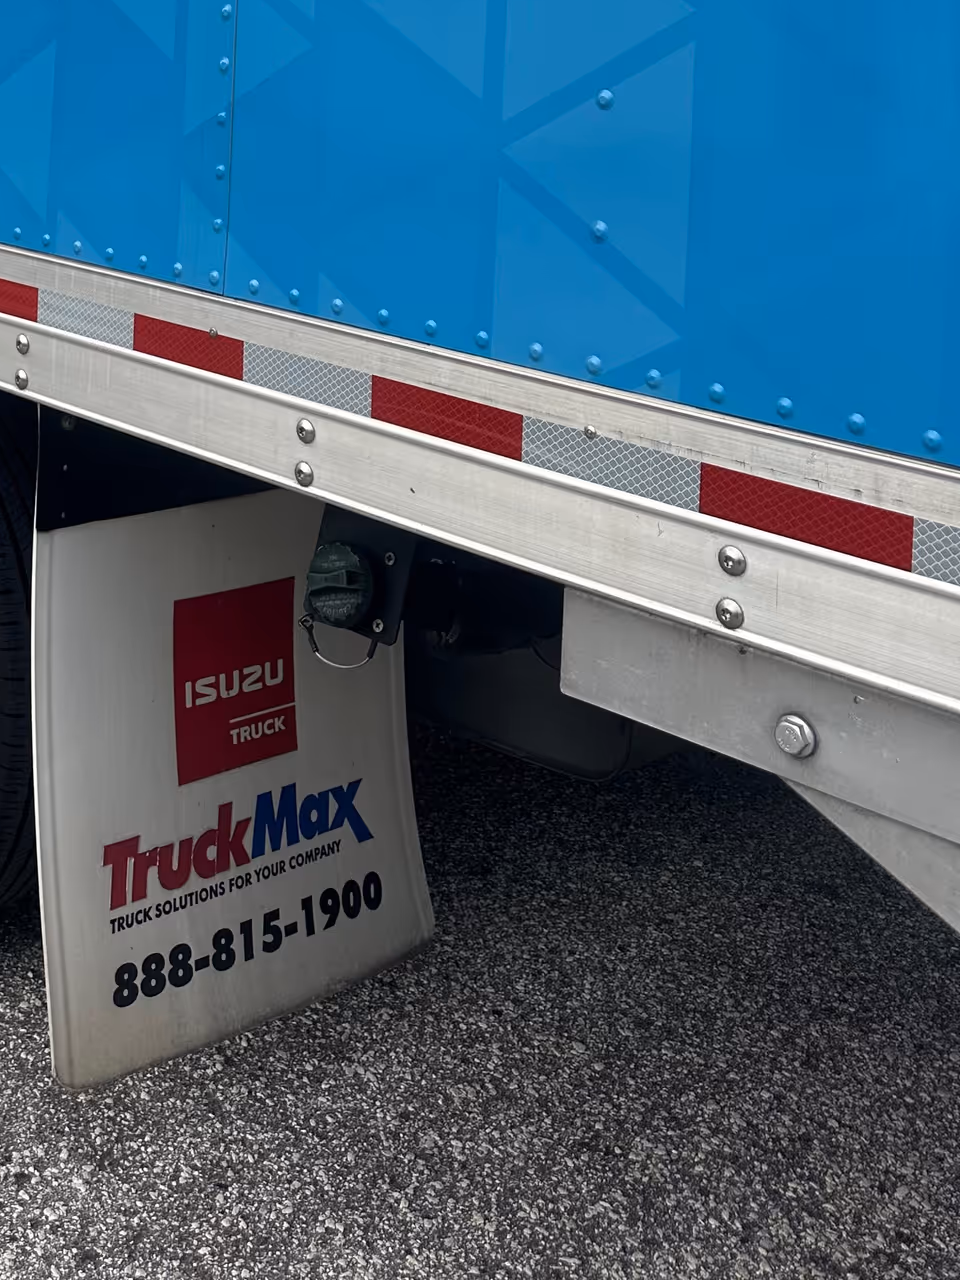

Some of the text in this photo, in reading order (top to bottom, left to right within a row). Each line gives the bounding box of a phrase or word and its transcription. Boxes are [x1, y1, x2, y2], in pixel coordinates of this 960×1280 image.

[185, 658, 284, 708] ISUZU
[230, 715, 286, 745] TRUCK
[110, 839, 342, 934] TRUCK SOLUTIONS FOR YOUR COMPANY
[112, 871, 383, 1008] 888-815-1900
